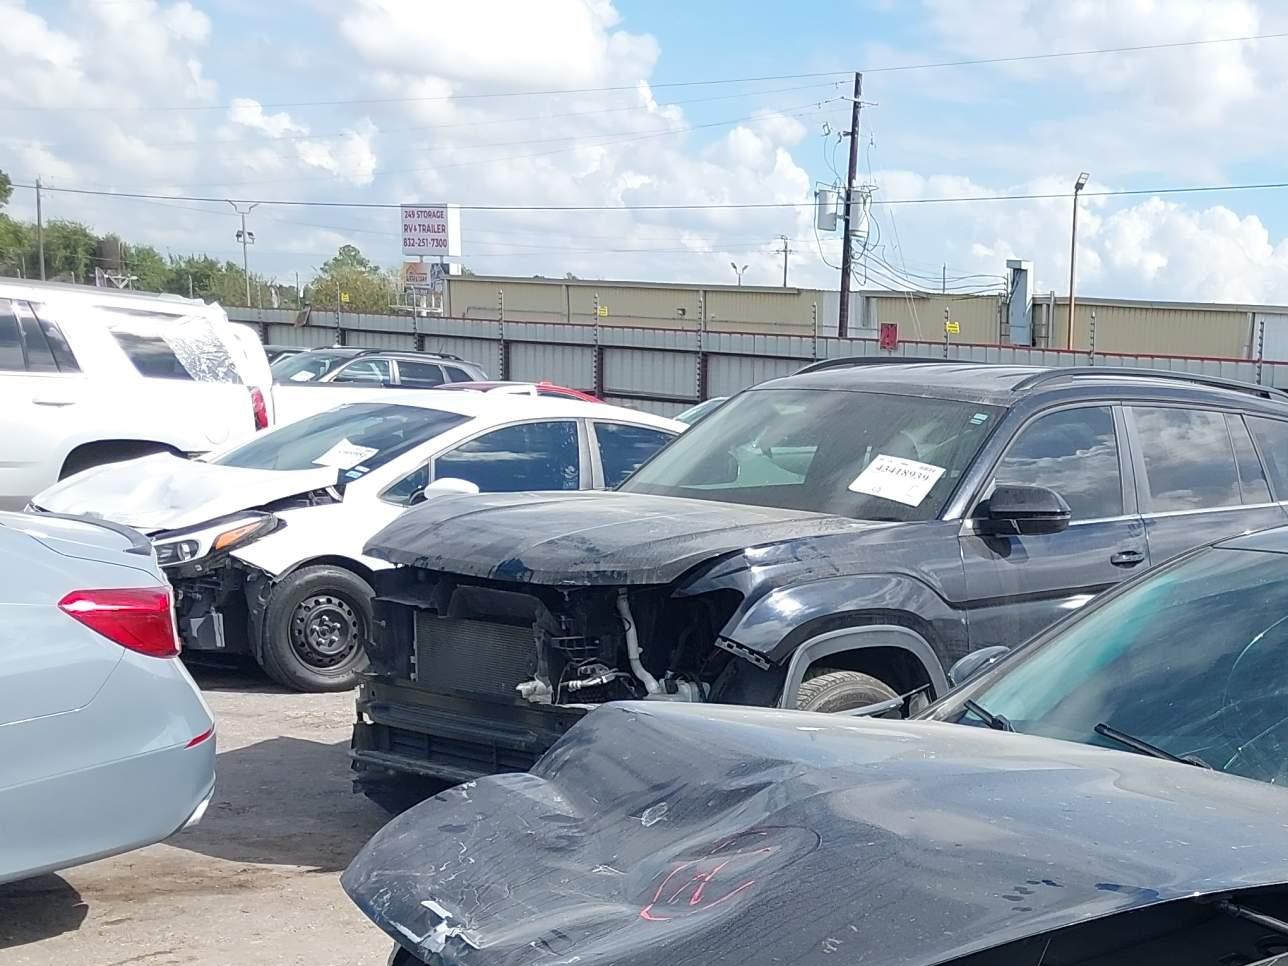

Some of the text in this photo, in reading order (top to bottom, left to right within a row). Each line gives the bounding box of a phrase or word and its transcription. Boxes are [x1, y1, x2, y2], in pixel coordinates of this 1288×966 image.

[416, 210, 445, 219] STORAGE
[403, 223, 414, 233] RV
[418, 223, 446, 233] TRAILER
